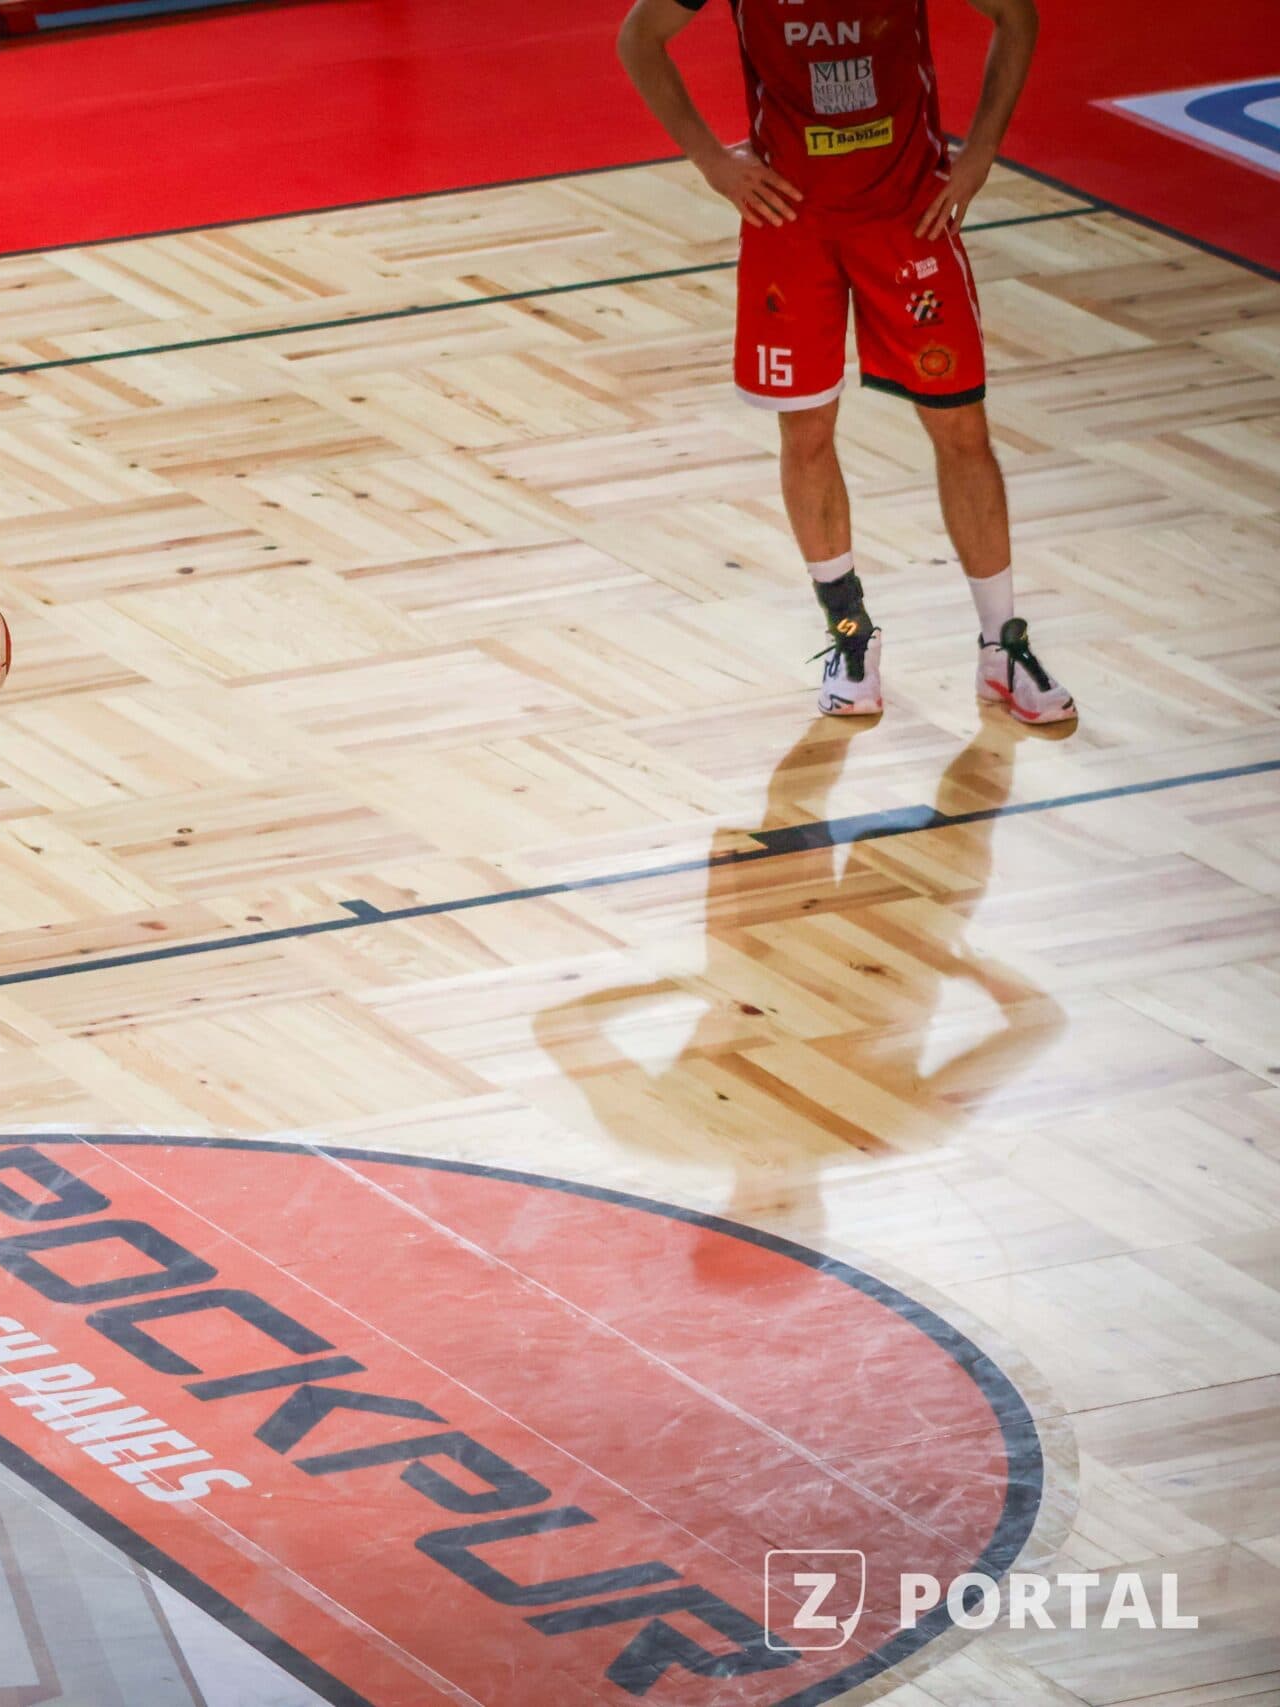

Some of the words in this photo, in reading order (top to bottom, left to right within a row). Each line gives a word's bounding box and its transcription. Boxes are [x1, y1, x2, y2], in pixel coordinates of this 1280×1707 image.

[783, 21, 861, 46] PAN
[813, 58, 871, 83] MIB
[836, 126, 889, 144] Babilon
[756, 344, 793, 387] 15
